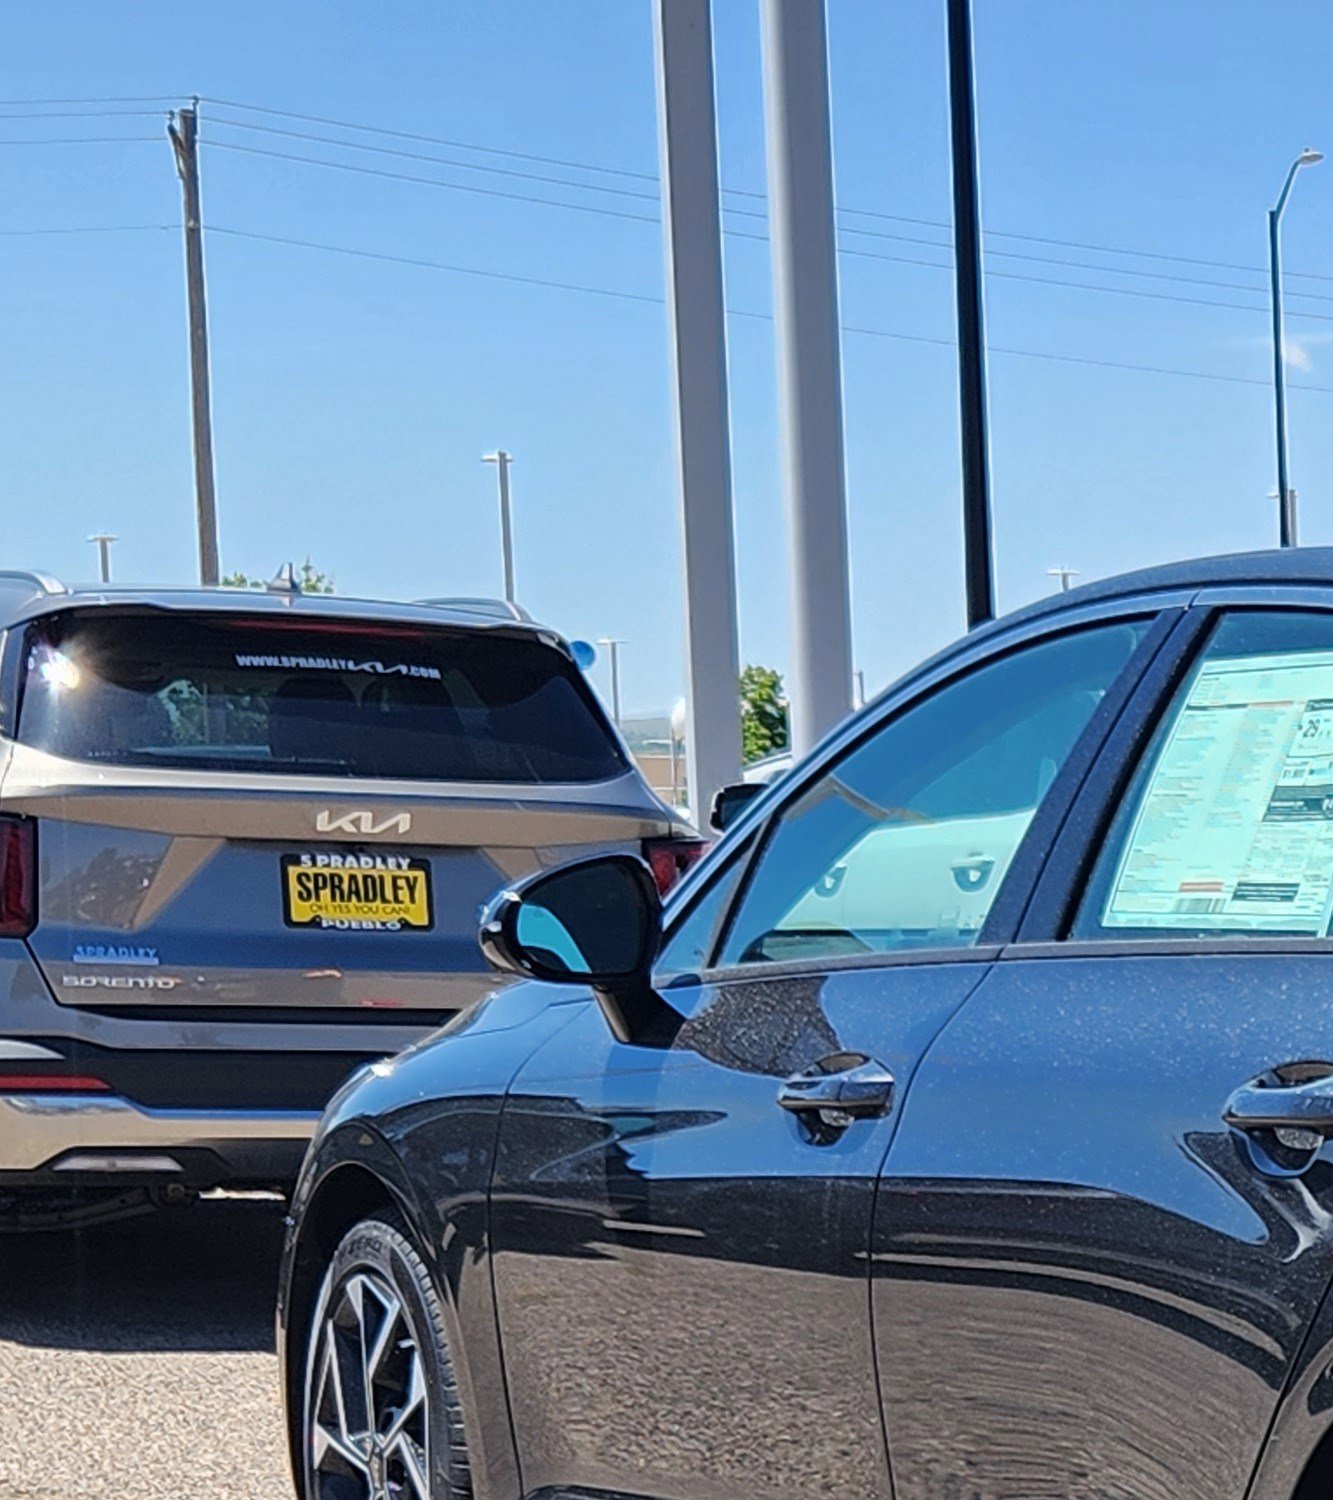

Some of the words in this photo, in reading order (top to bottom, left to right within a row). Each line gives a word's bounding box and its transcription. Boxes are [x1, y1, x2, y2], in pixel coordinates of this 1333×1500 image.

[316, 810, 411, 834] KIA
[300, 854, 411, 872] SPRADLEY
[296, 872, 418, 905] SPRADLEY
[354, 905, 379, 916] YOU
[76, 945, 158, 959] SPRADLEY
